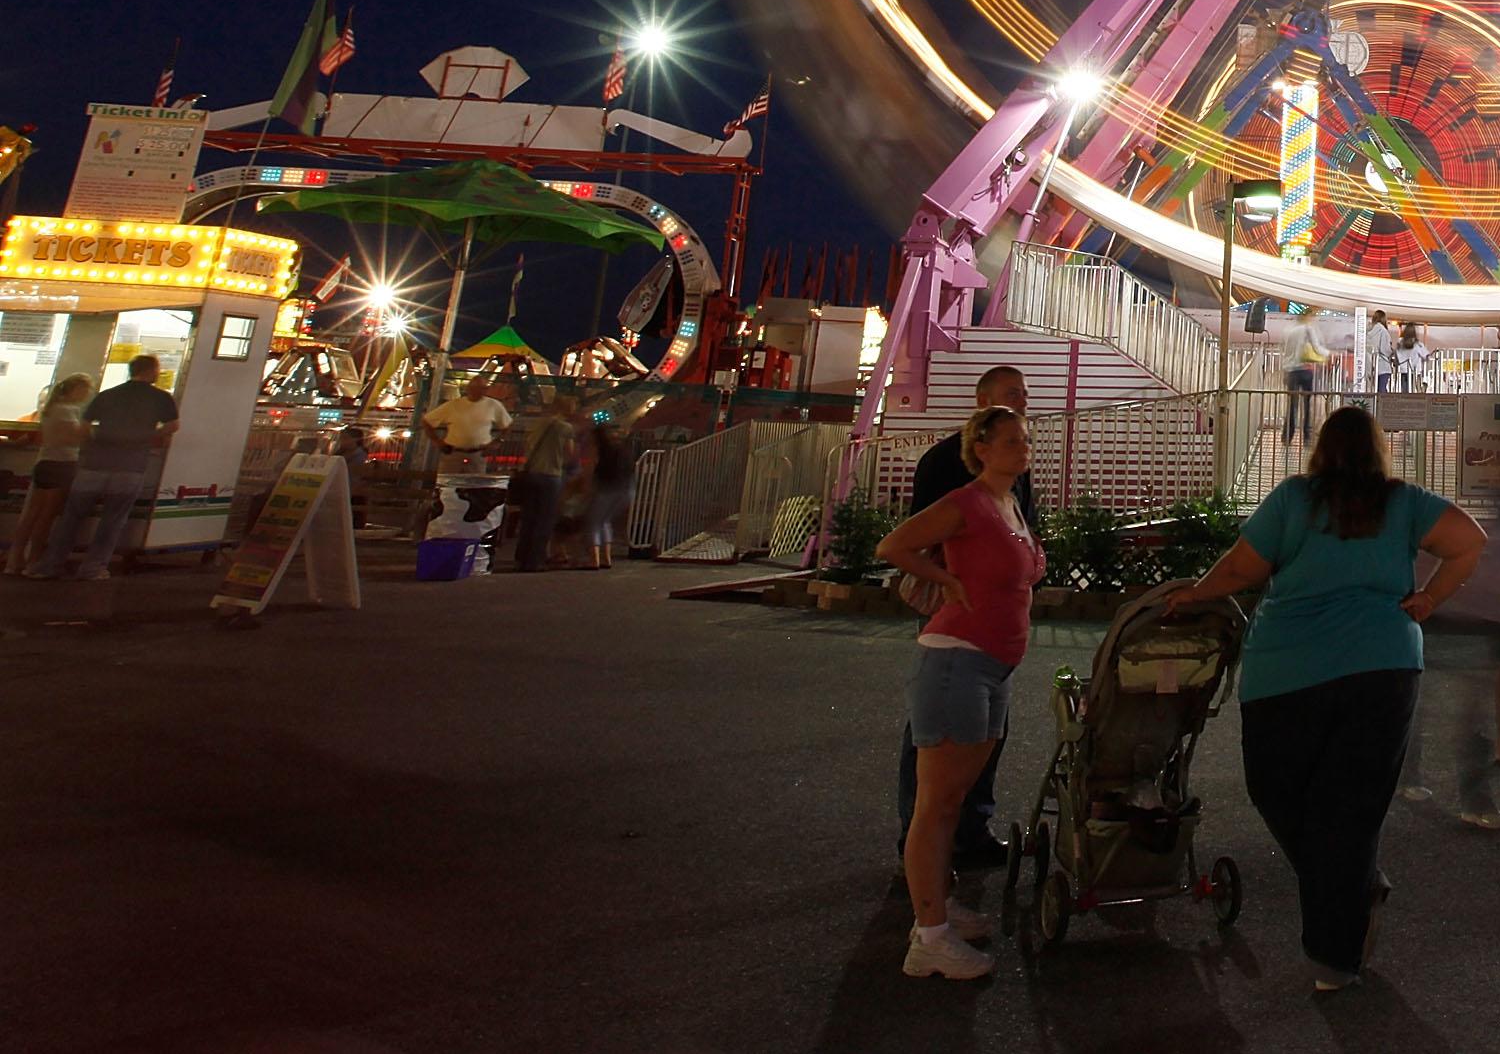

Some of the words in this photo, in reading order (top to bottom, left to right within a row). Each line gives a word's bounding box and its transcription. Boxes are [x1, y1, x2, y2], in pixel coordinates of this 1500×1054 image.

[90, 104, 153, 119] Ticket
[158, 108, 200, 121] Info
[33, 234, 192, 268] TICKETS
[227, 246, 280, 278] TICKETS
[894, 433, 935, 449] ENTER
